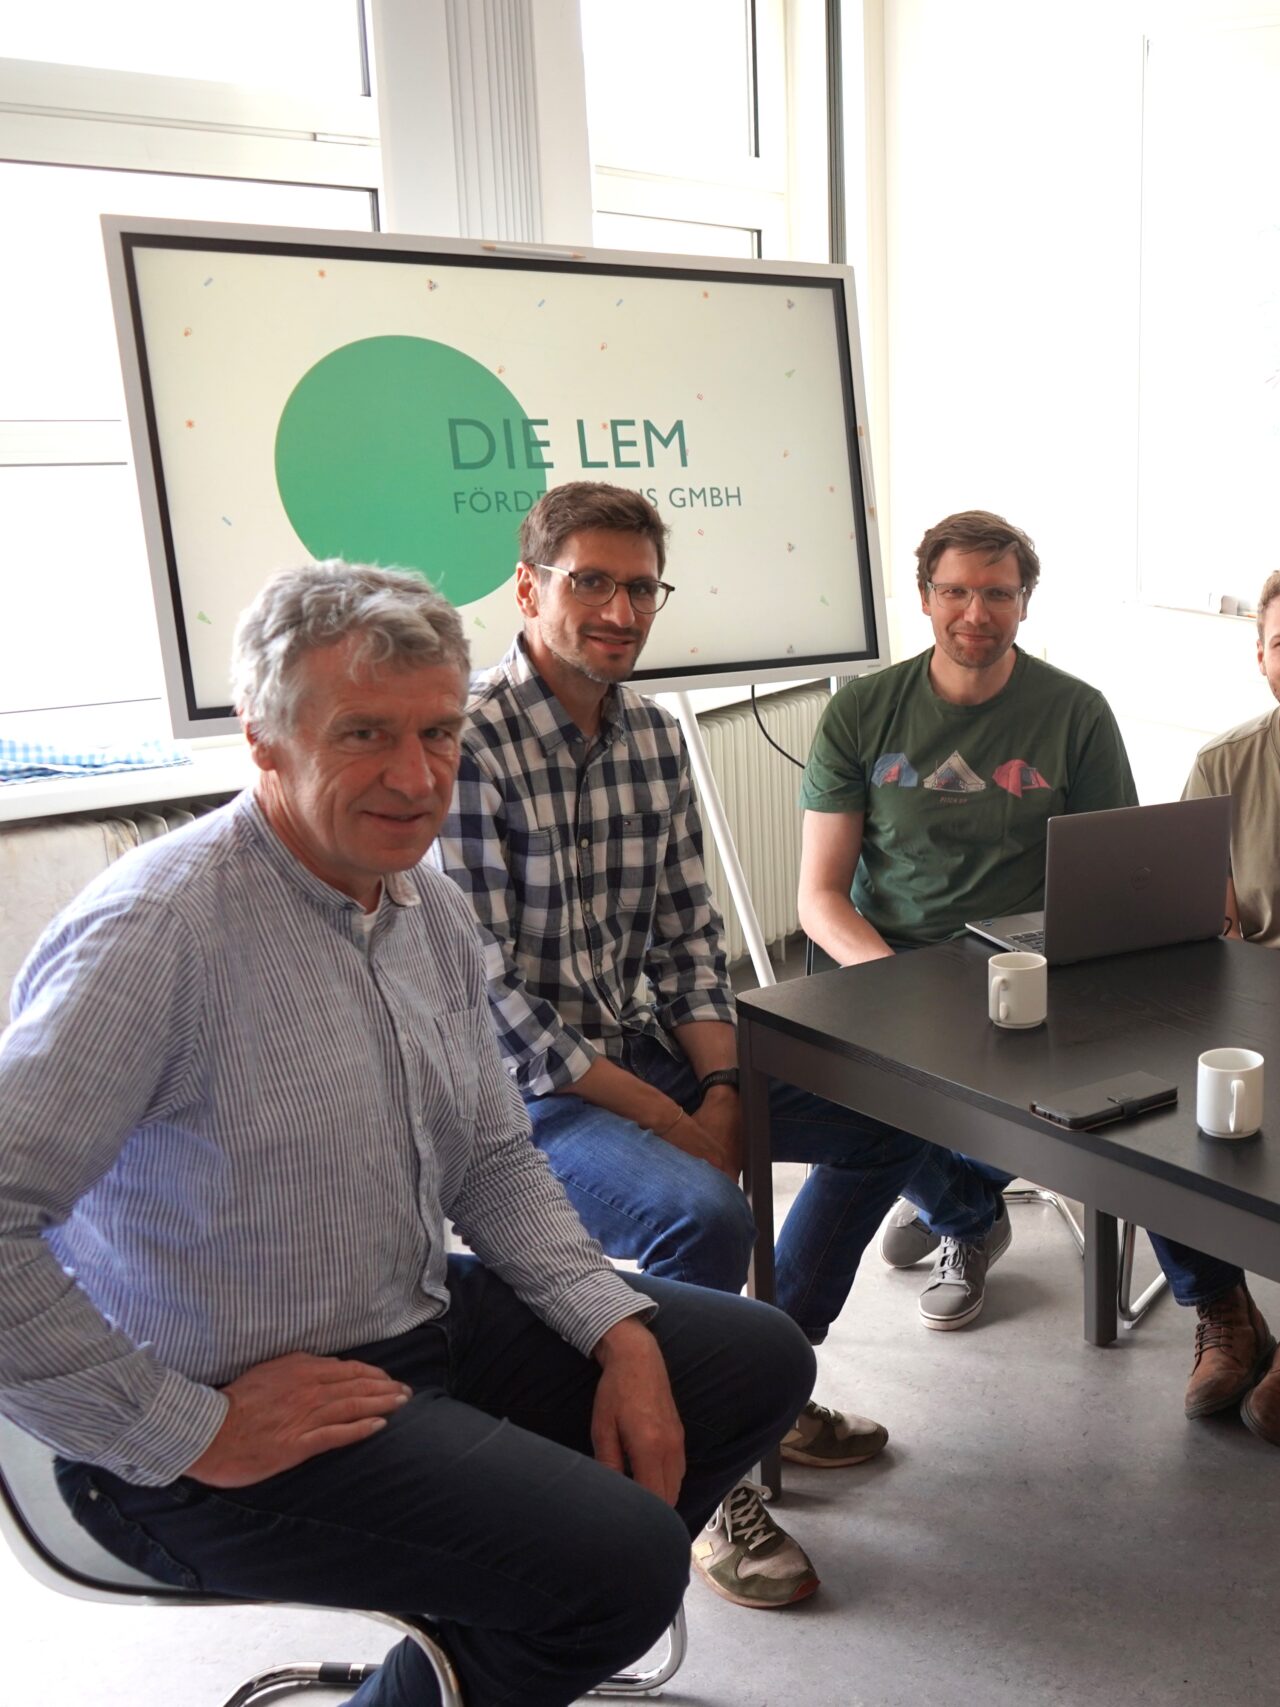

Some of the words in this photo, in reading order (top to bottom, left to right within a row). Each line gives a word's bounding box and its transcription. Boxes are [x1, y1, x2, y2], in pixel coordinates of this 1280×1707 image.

[448, 418, 554, 470] DIE
[577, 419, 688, 468] LEM
[453, 487, 658, 514] FÖRDS
[669, 486, 742, 508] GMBH
